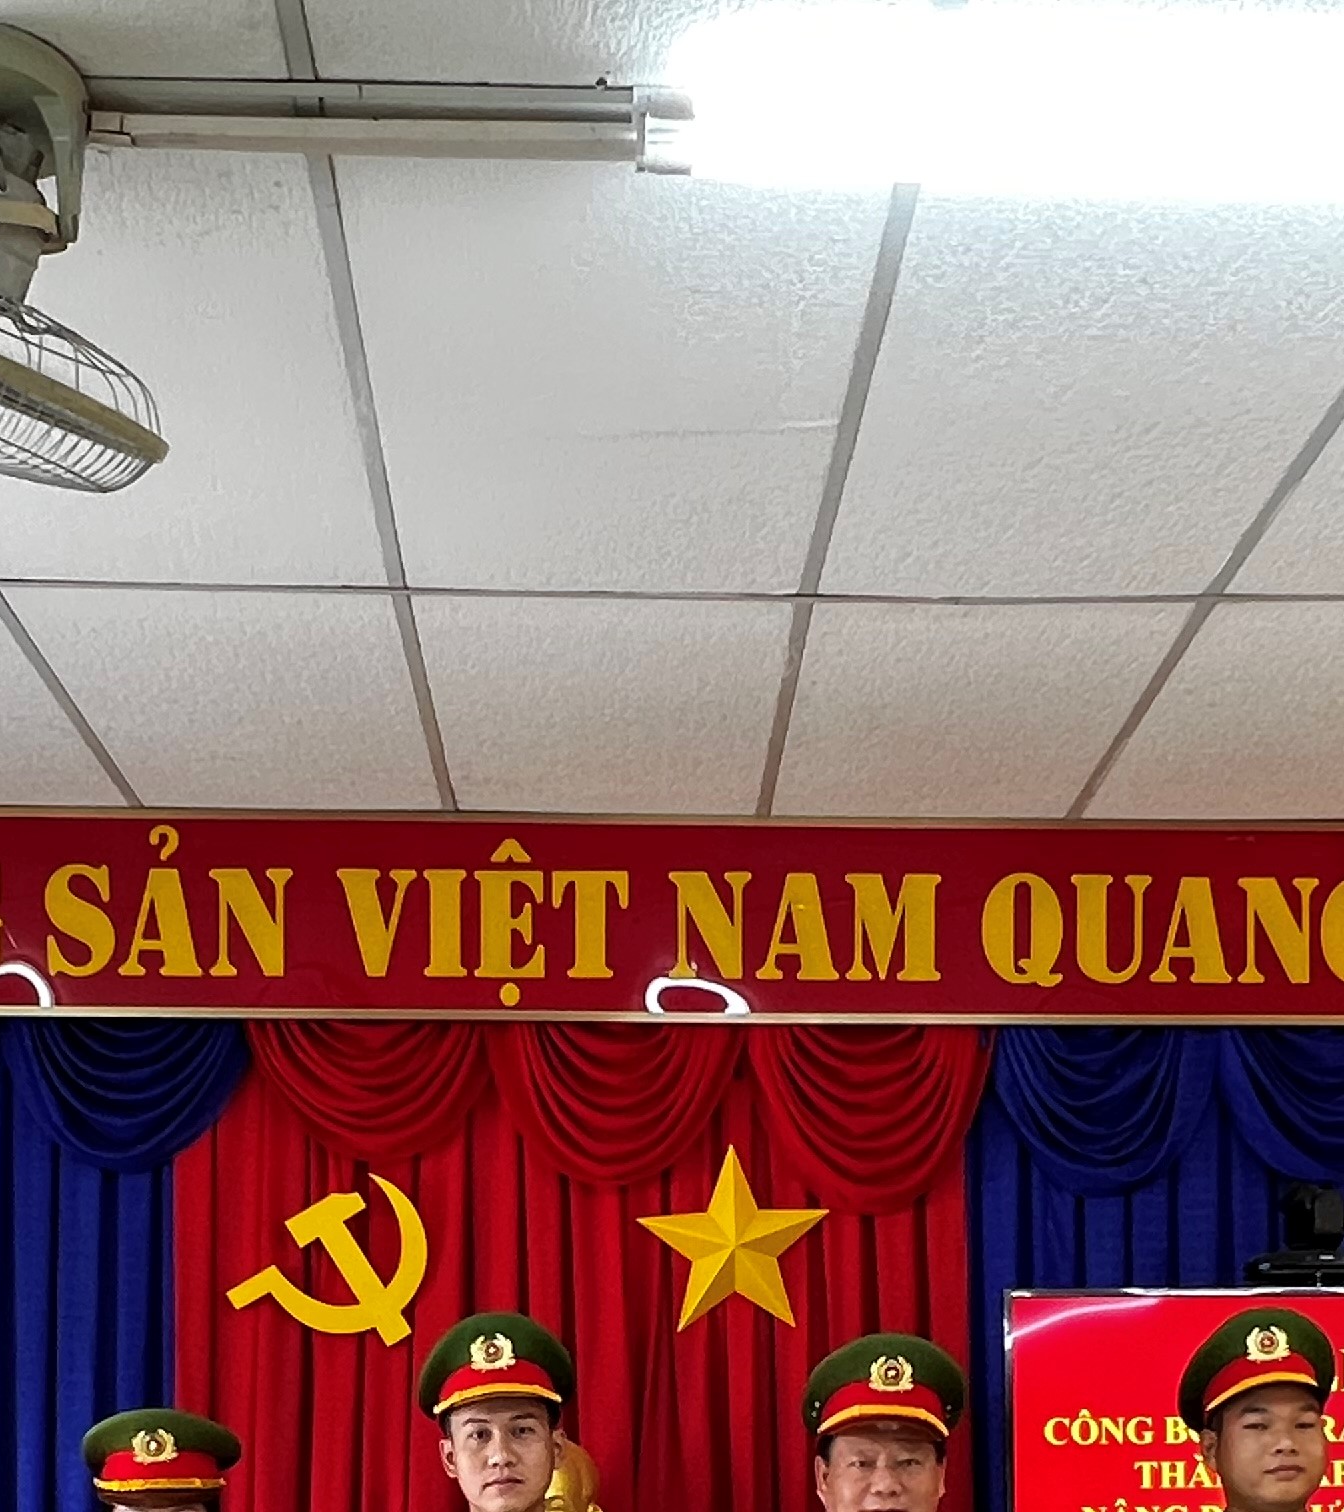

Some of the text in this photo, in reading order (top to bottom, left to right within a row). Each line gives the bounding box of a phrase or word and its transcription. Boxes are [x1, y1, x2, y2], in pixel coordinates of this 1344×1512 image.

[44, 825, 293, 978] SẢN
[337, 838, 630, 1007] VIỆT
[668, 869, 942, 981] NAM
[1043, 1408, 1154, 1446] CÔNG
